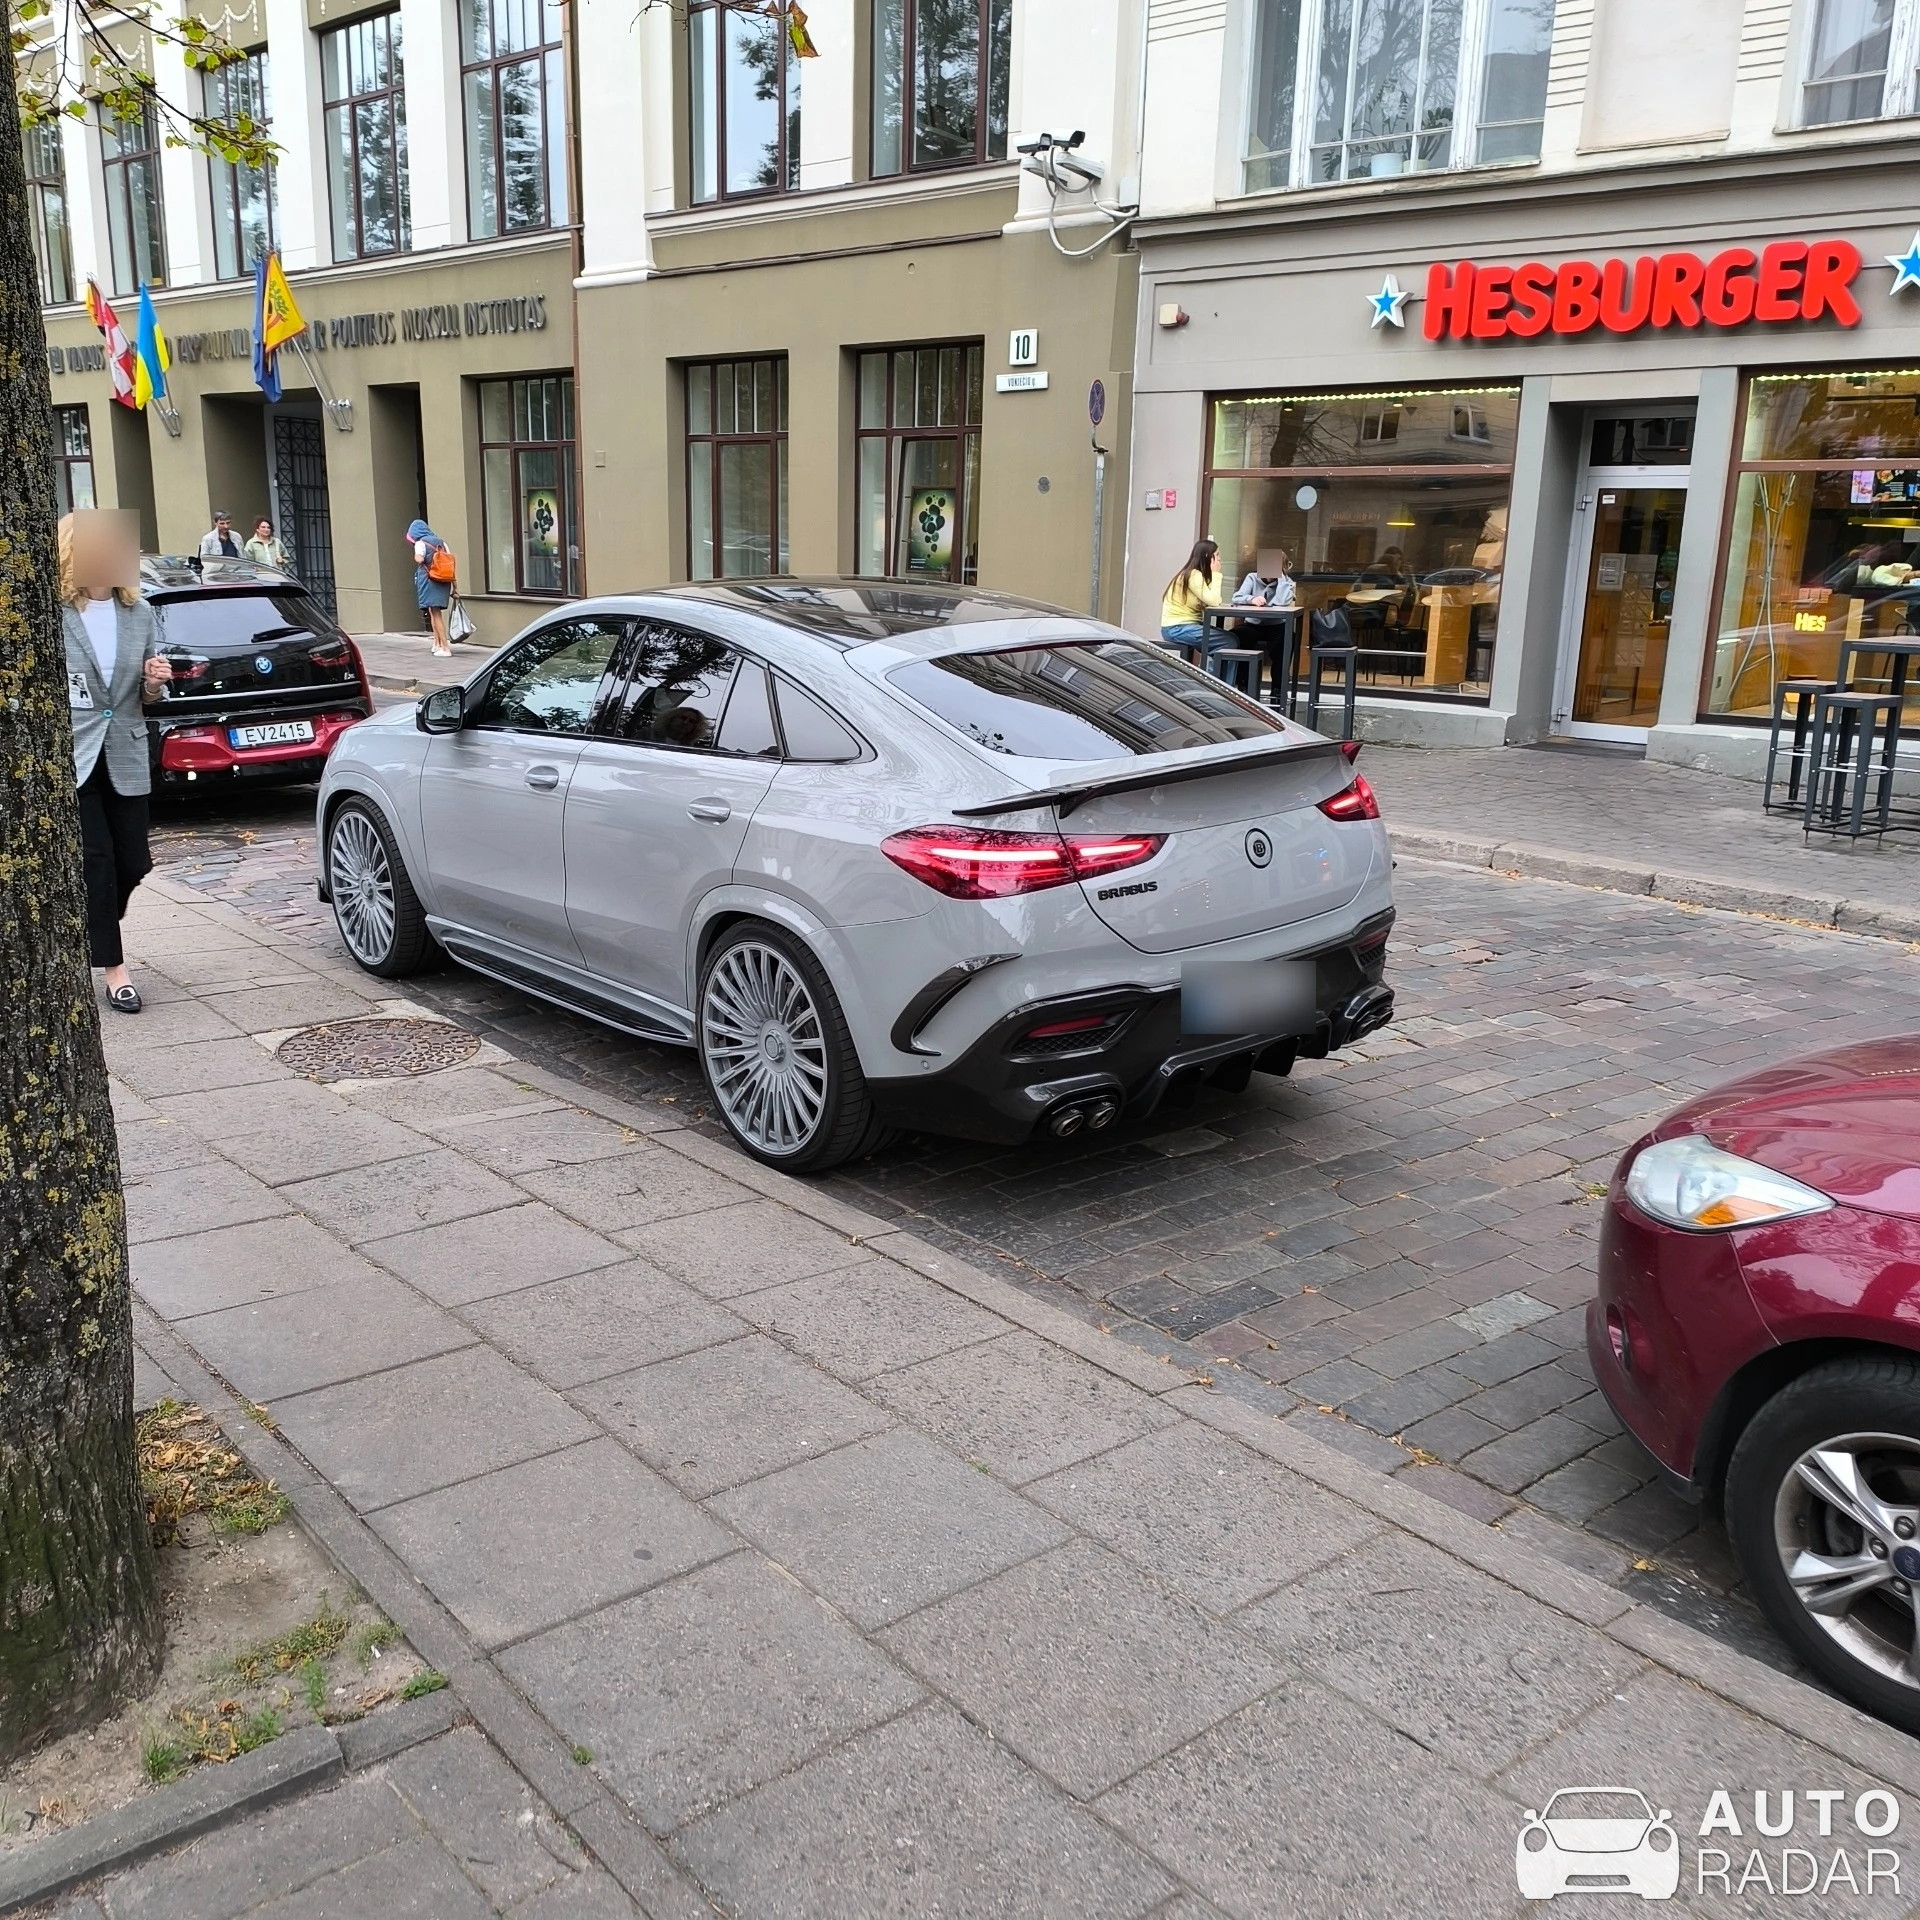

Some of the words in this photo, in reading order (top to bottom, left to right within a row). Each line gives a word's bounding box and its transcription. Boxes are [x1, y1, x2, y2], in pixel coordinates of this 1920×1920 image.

[1423, 239, 1863, 342] HESBURGER
[330, 311, 397, 348] POLITIKOS
[463, 294, 547, 336] INSTITUTAS
[1015, 334, 1030, 360] 10
[1795, 612, 1827, 632] HES
[245, 723, 306, 743] EV2415
[1098, 881, 1158, 900] BRABUS
